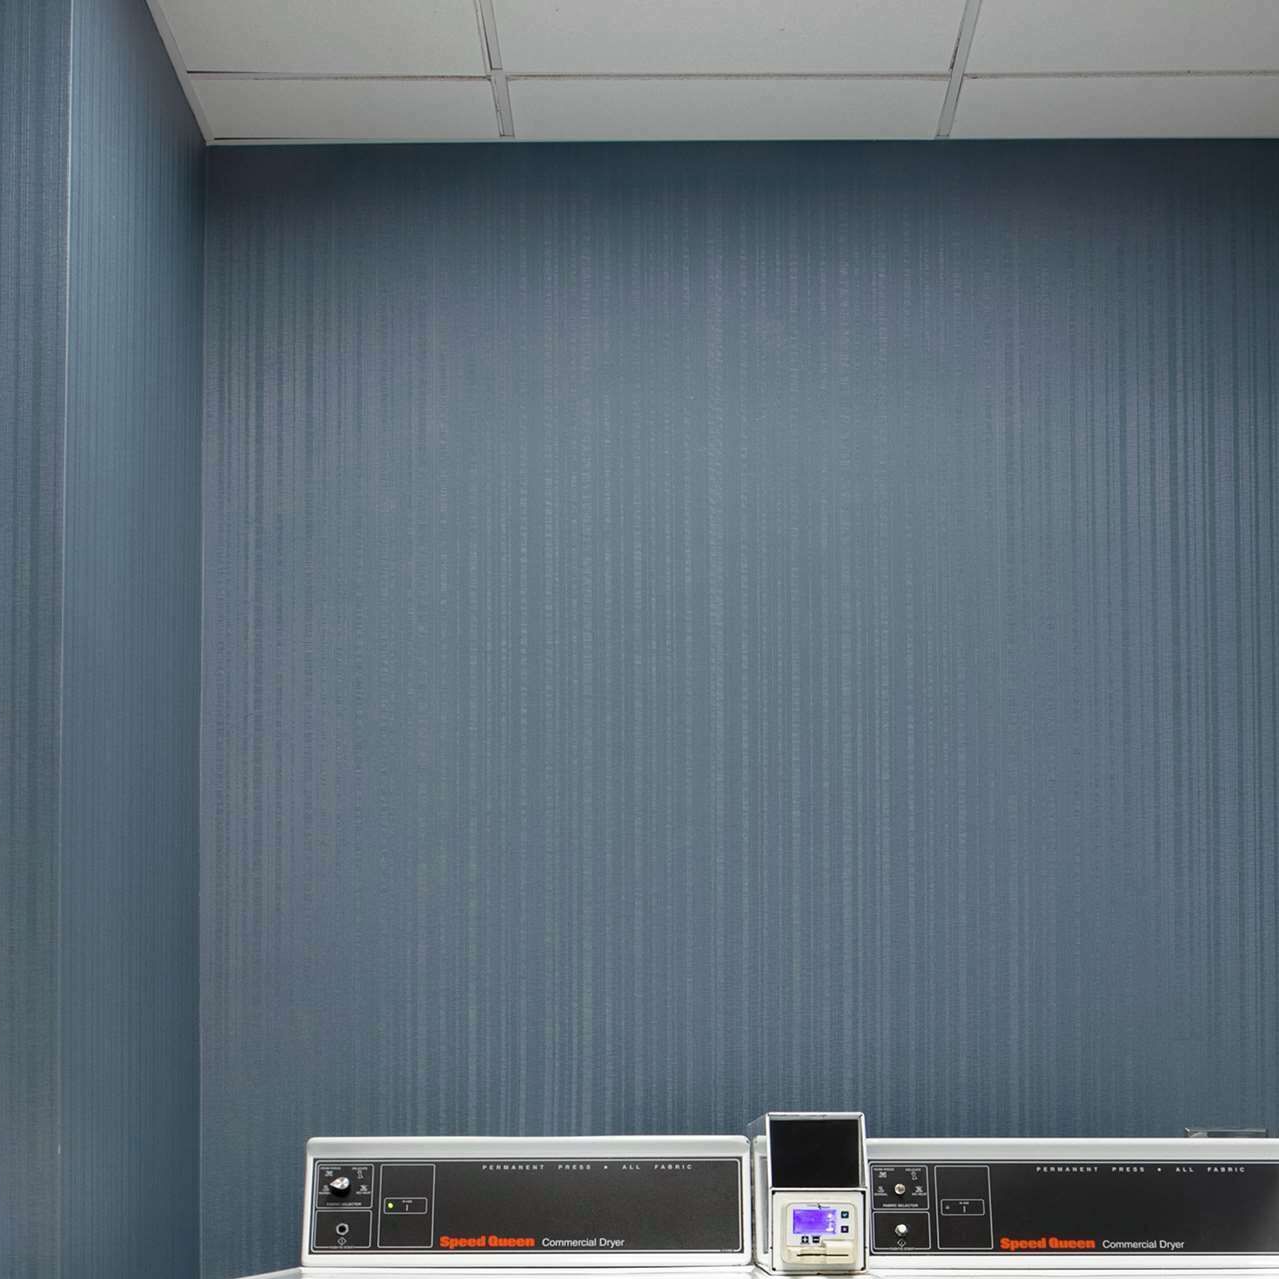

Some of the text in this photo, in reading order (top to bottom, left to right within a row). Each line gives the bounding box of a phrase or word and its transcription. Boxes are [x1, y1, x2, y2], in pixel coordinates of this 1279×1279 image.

[439, 1235, 625, 1249] Speed Queen Commercial Dryer
[1000, 1236, 1185, 1250] Speed Queen Commercial Dryer
